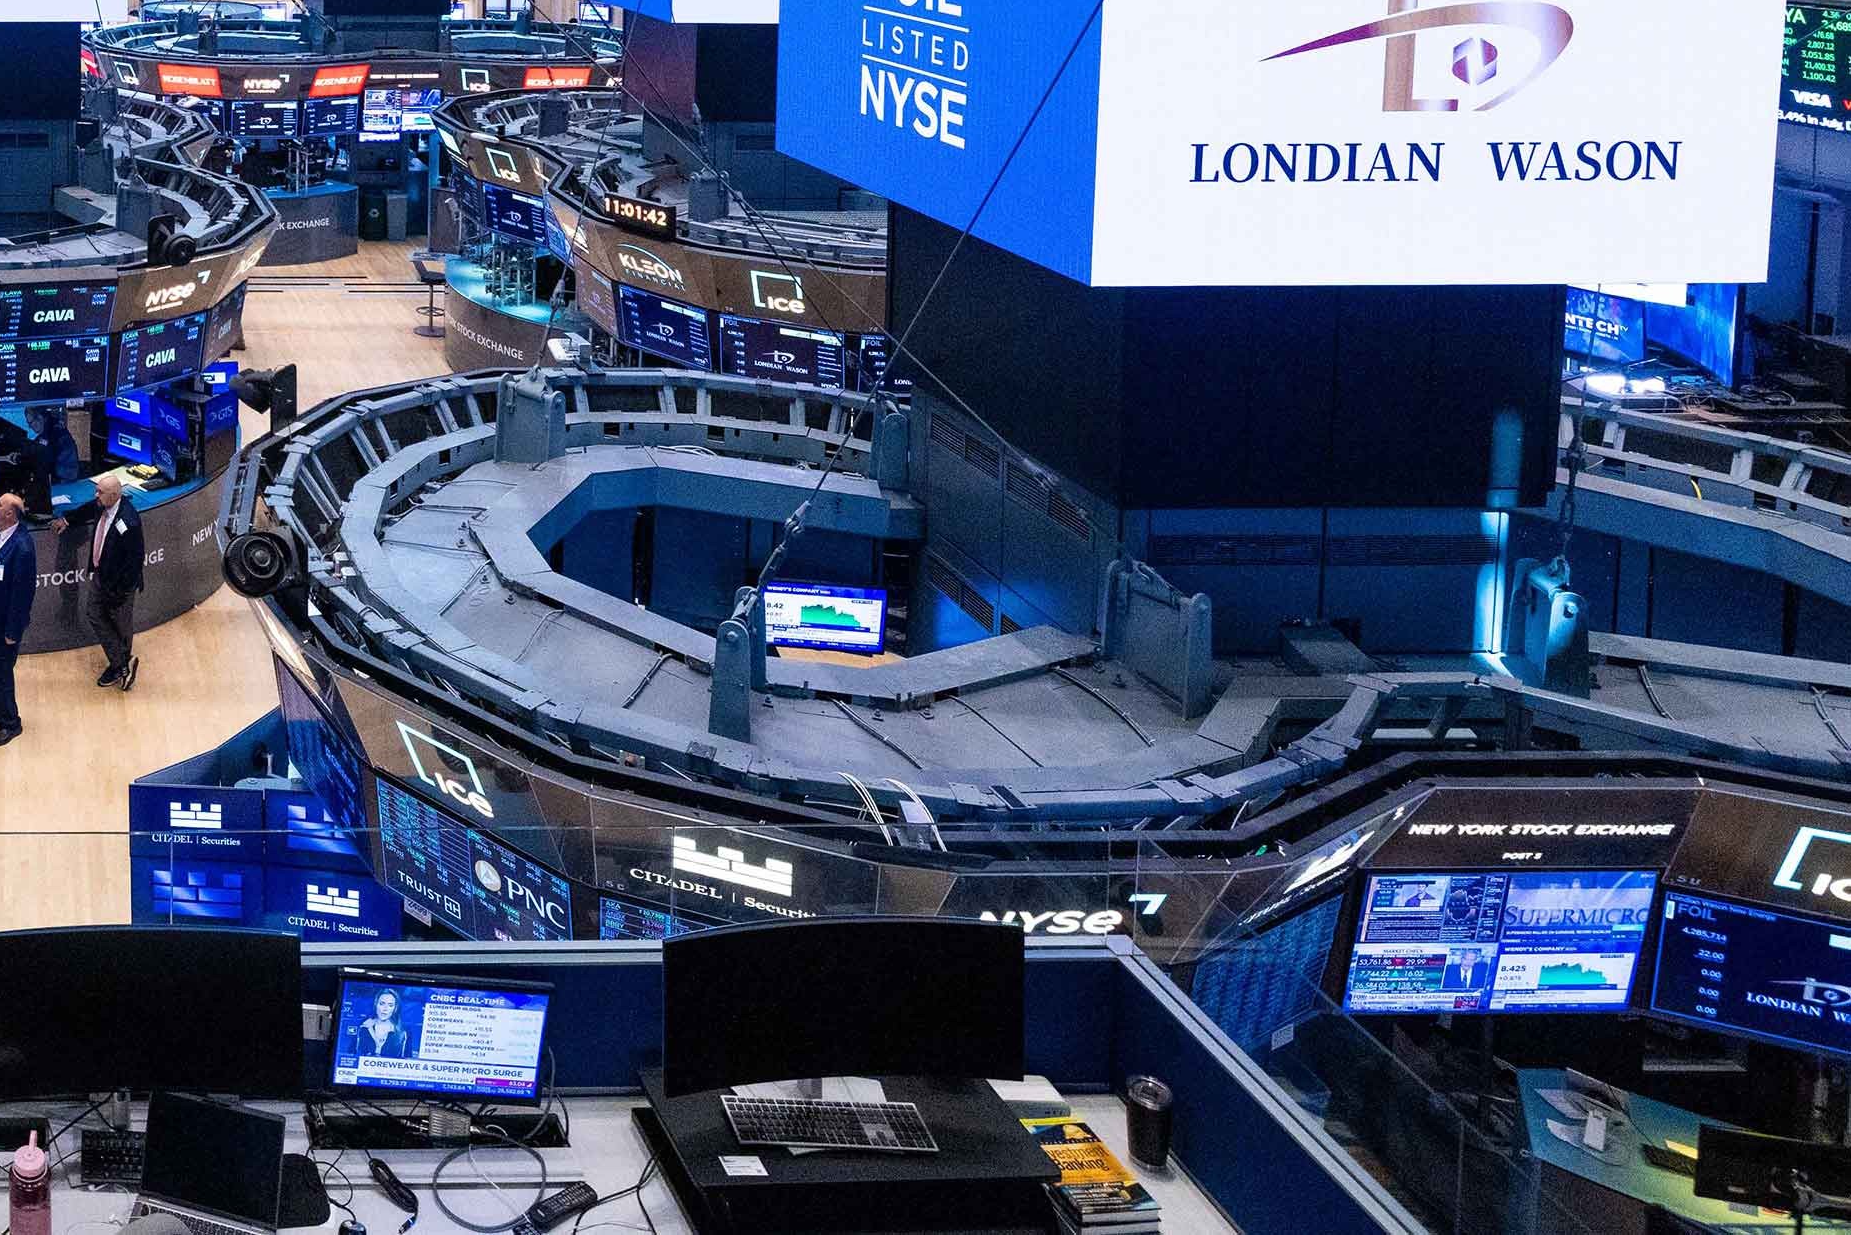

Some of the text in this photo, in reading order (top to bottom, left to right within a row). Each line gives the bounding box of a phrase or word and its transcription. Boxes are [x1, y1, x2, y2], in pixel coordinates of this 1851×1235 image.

[862, 18, 969, 71] LISTED
[860, 64, 967, 149] NYSE
[1790, 89, 1832, 108] VISA
[1190, 141, 1682, 183] LONDIAN WASON
[605, 198, 667, 226] 11:01:42
[287, 218, 330, 230] EXCHANGE
[33, 310, 75, 323] CAVA
[456, 324, 476, 342] STOCK
[476, 327, 524, 361] EXCHANGE
[145, 348, 176, 368] CAVA
[29, 367, 70, 384] CAVA
[786, 365, 808, 374] WASON
[192, 526, 214, 547] NEW
[1408, 823, 1674, 836] NEW YORK STOCK EXCHANGE
[152, 832, 241, 847] CITADEL Securities
[397, 869, 442, 904] TRUIST
[629, 868, 723, 899] CITADEL
[504, 875, 566, 930] PNC
[1678, 904, 1716, 922] FOIL
[288, 916, 378, 937] CITADEL Securities
[1698, 949, 1725, 961] 22.00
[1700, 968, 1722, 979] 0.00
[430, 994, 506, 1006] CNBC REAL-TIME
[1698, 986, 1719, 997] 0.00
[1695, 1004, 1717, 1015] 0.00
[1746, 992, 1822, 1018] LONDIAN
[363, 1059, 421, 1071] COREWEAVE
[430, 1064, 460, 1074] SUPER
[462, 1067, 492, 1076] MICRO
[493, 1069, 524, 1078] SURGE
[1046, 1144, 1109, 1160] vestment
[1054, 1155, 1110, 1172] Banking
